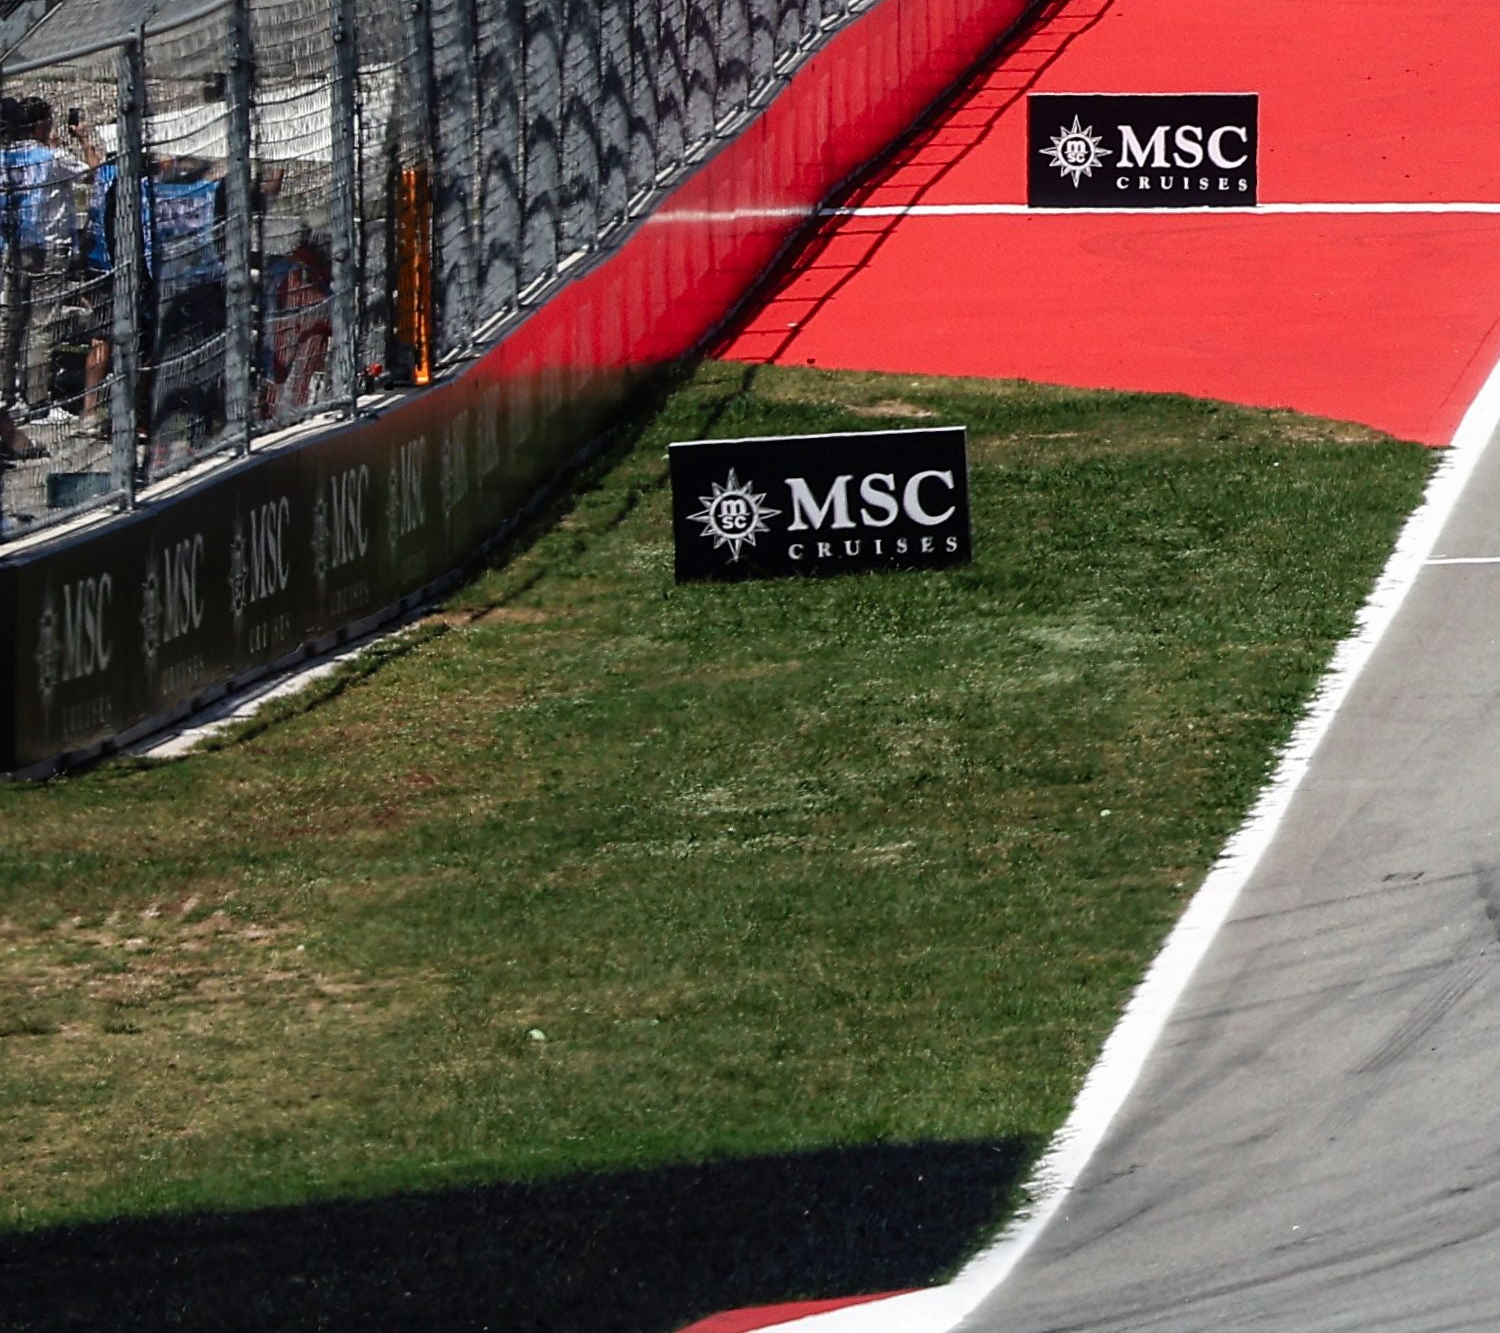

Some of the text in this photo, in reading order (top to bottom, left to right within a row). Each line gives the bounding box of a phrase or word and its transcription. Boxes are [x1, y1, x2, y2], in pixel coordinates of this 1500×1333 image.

[1115, 124, 1249, 170] MSC
[1116, 176, 1249, 192] CRUISES
[331, 463, 369, 568] MSC
[783, 469, 957, 532] MSC
[163, 533, 204, 644] MSC
[250, 494, 290, 604] MSC
[787, 535, 959, 561] CRUISES
[62, 572, 112, 682] MSC
